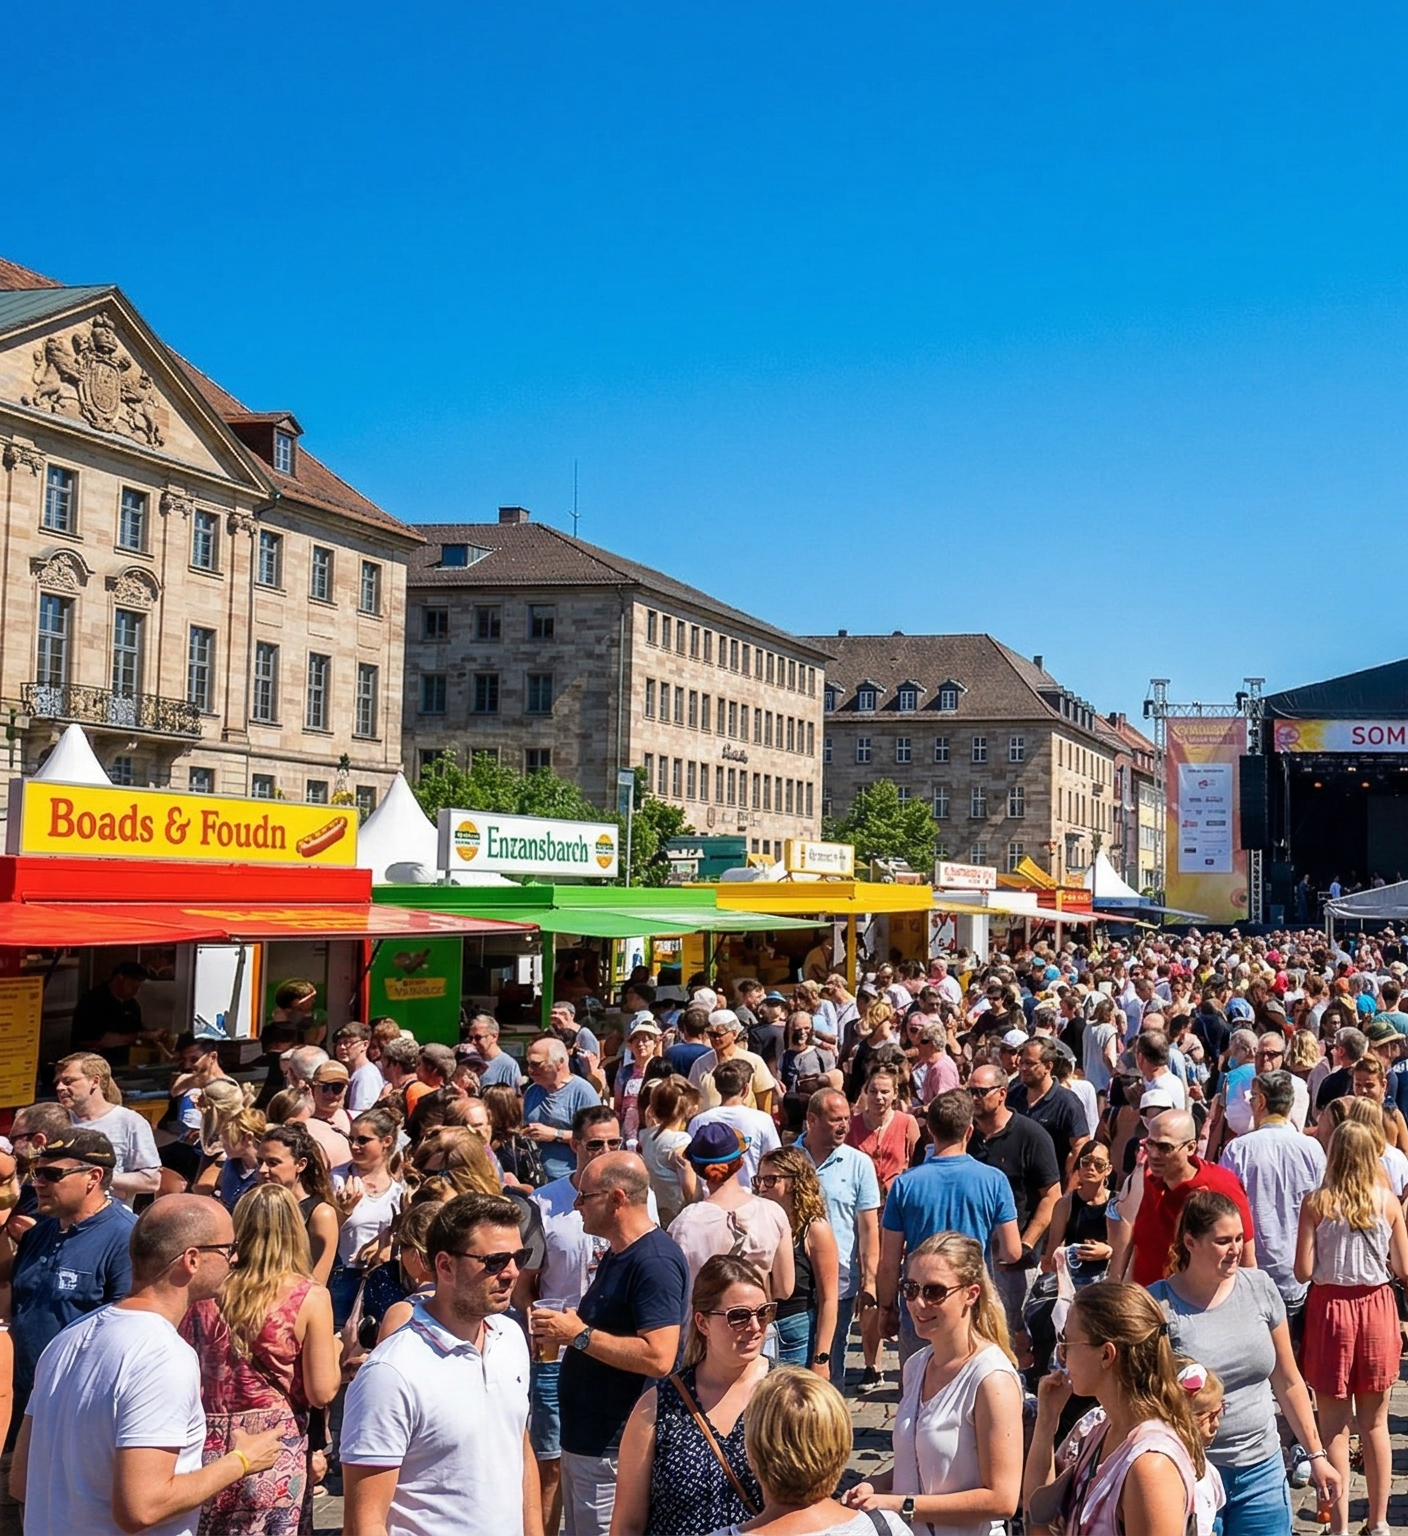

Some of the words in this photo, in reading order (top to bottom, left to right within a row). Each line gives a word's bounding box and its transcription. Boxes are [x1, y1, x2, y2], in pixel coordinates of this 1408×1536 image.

[47, 797, 154, 843] Boads
[164, 806, 191, 845] &
[200, 809, 287, 850] Foudn
[487, 826, 589, 863] Enzansbarch
